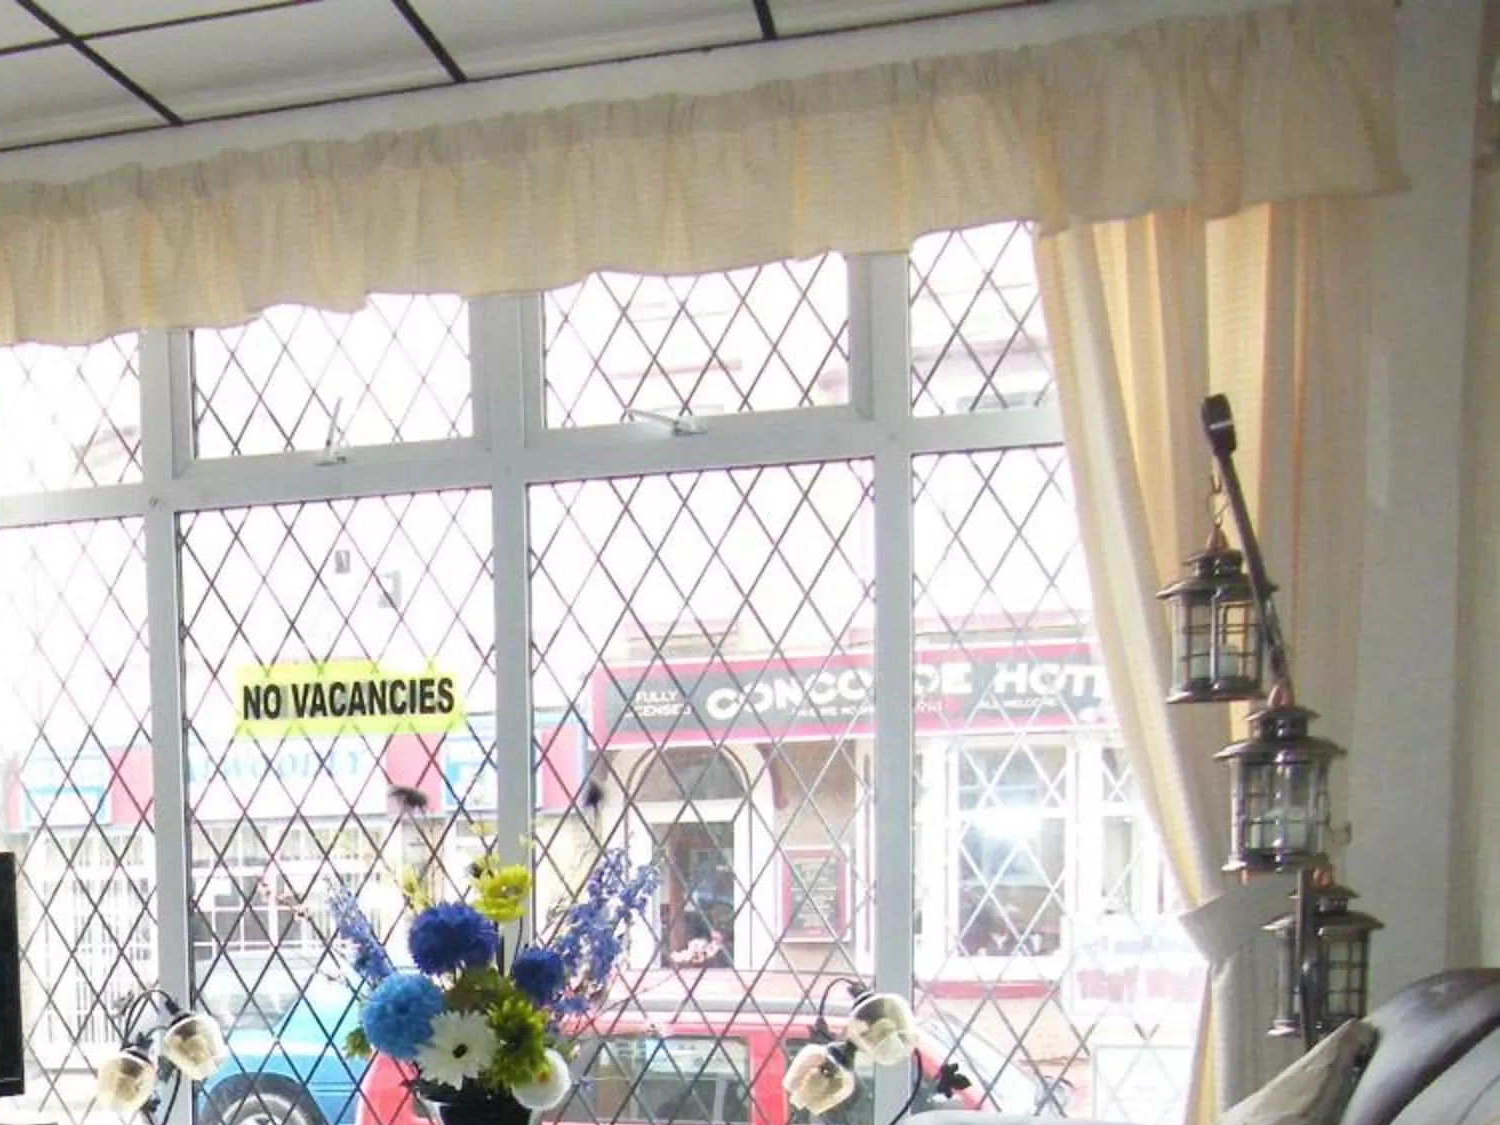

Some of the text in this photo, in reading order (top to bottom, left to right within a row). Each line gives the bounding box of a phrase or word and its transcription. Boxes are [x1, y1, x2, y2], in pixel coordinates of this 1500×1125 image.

[243, 678, 455, 720] NO VACANCIES
[706, 661, 973, 720] CONCODE
